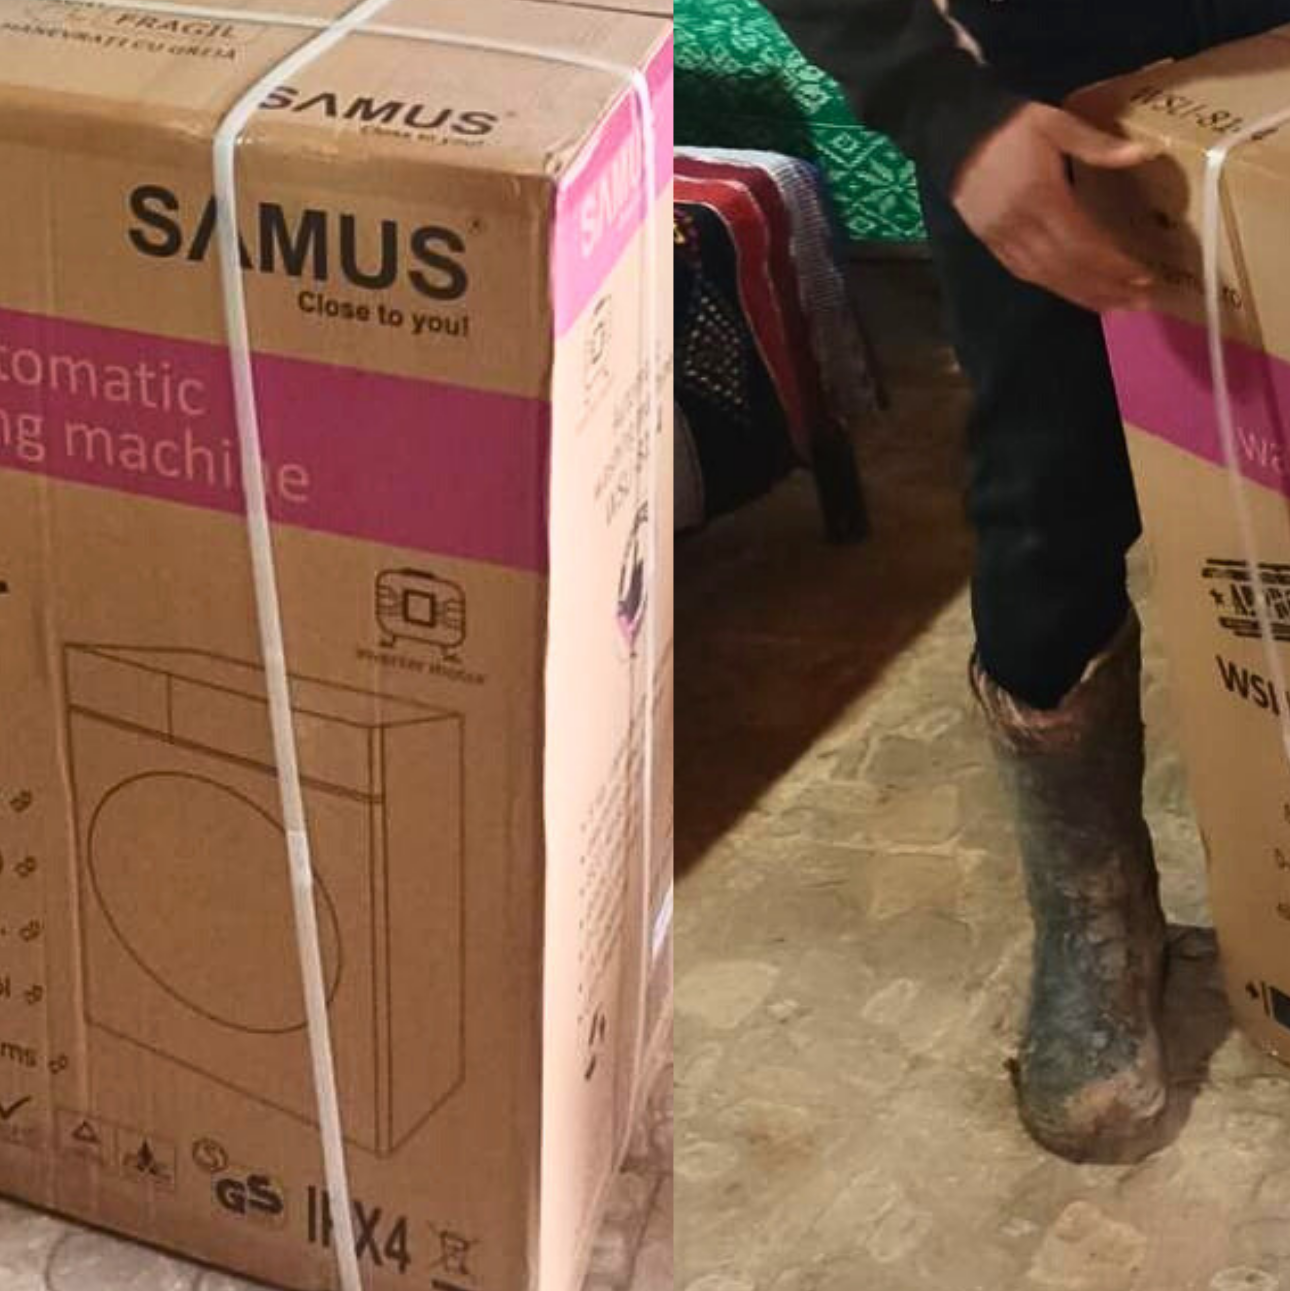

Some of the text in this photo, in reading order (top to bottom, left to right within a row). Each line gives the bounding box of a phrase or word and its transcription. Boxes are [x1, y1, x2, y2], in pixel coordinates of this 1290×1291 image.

[114, 11, 239, 39] FRAGIL
[258, 86, 499, 136] SAMUS
[127, 184, 469, 301] SAMUS
[297, 290, 470, 338] Close to you!
[64, 419, 310, 503] machie
[214, 1173, 284, 1215] GS
